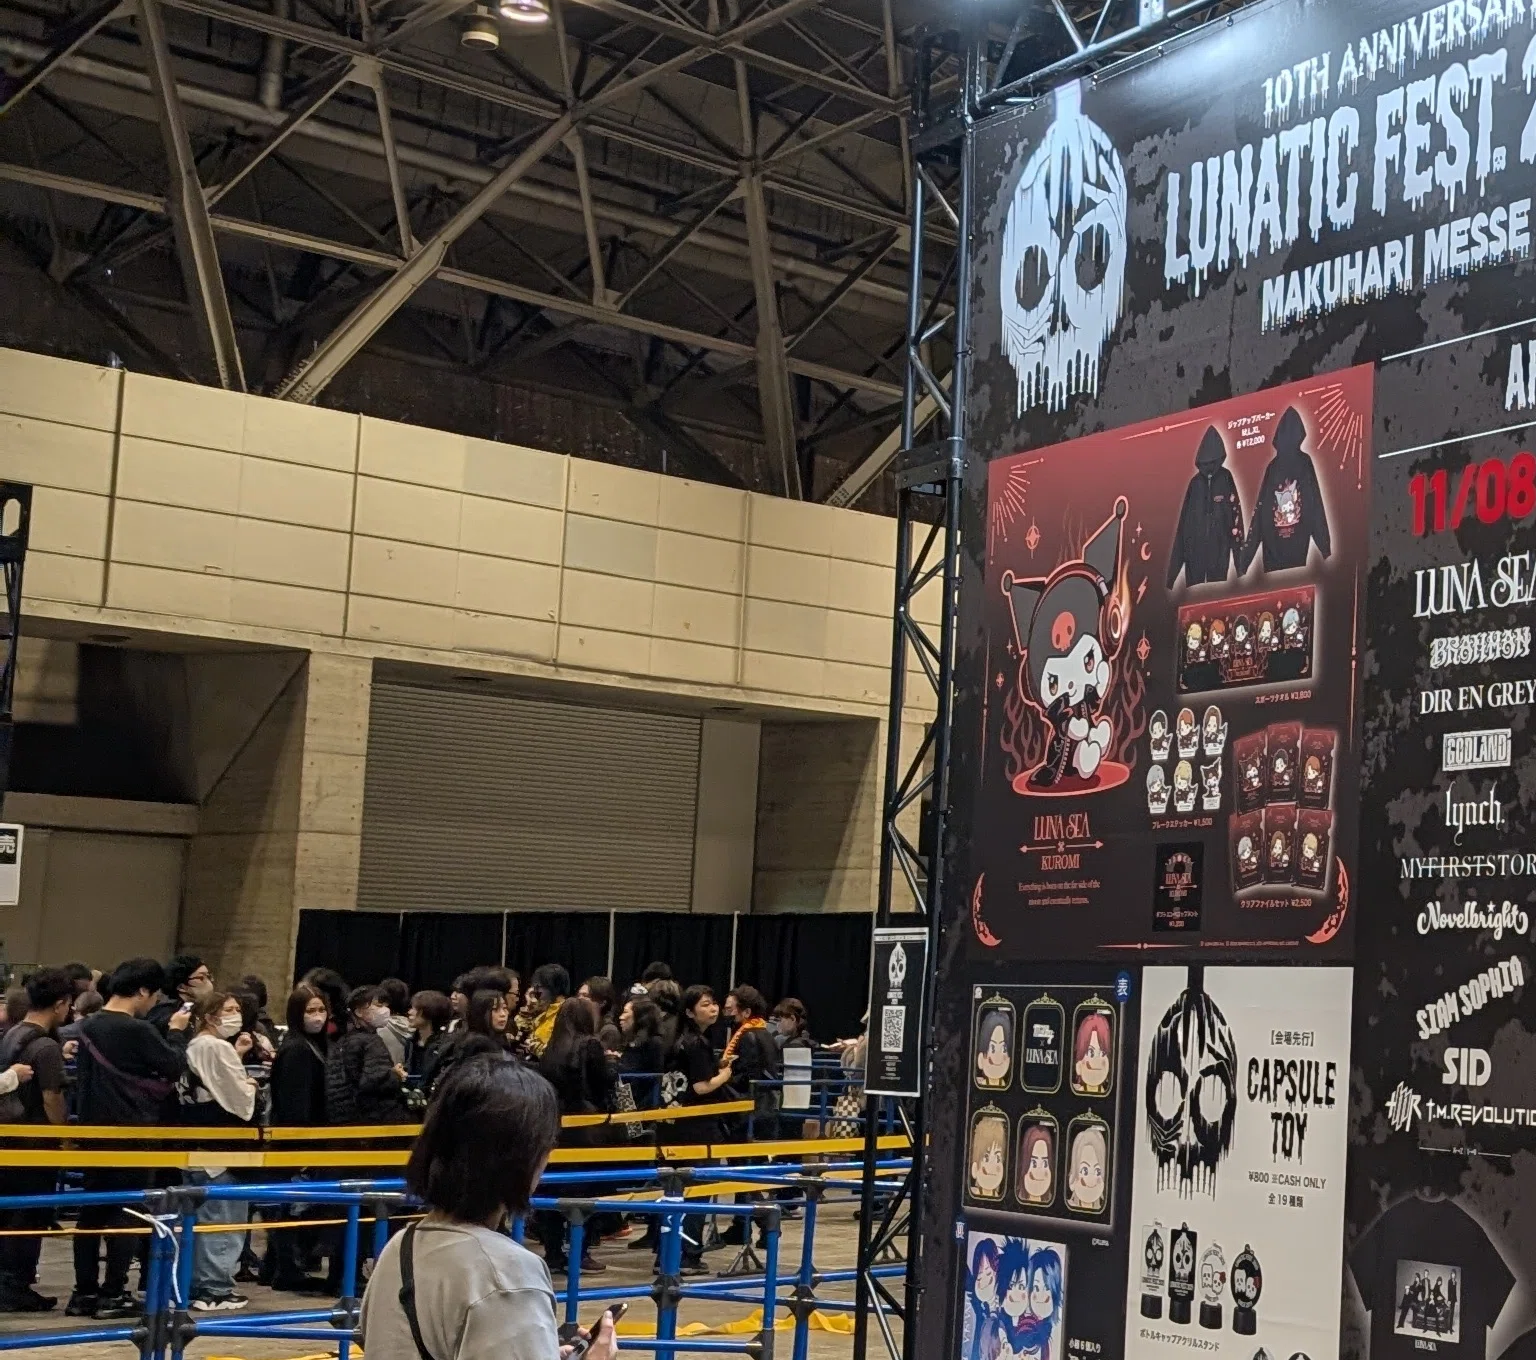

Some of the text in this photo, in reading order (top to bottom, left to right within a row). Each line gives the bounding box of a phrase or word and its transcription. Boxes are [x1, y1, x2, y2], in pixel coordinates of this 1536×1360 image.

[1262, 52, 1331, 127] 10TH
[1164, 104, 1359, 296] LUNATIC
[1372, 47, 1507, 218] FEST.
[1260, 198, 1532, 334] MAKUHARI MESSE
[1413, 556, 1488, 619] LUNA
[1429, 626, 1532, 669] BRAHMAN
[1420, 685, 1453, 715] DIR
[1458, 685, 1484, 710] EN
[1446, 732, 1508, 766] GODLAND
[1034, 812, 1091, 840] LUNA SEA
[1445, 780, 1505, 846] lynch.
[1041, 854, 1080, 870] KUROMI
[1416, 900, 1529, 940] Novelbright
[1416, 955, 1525, 1039] SIAM SOPHIA
[1247, 1057, 1337, 1112] CAPSULE
[1442, 1047, 1491, 1086] SID
[1271, 1112, 1308, 1165] TOY
[1304, 1176, 1327, 1189] ONLY
